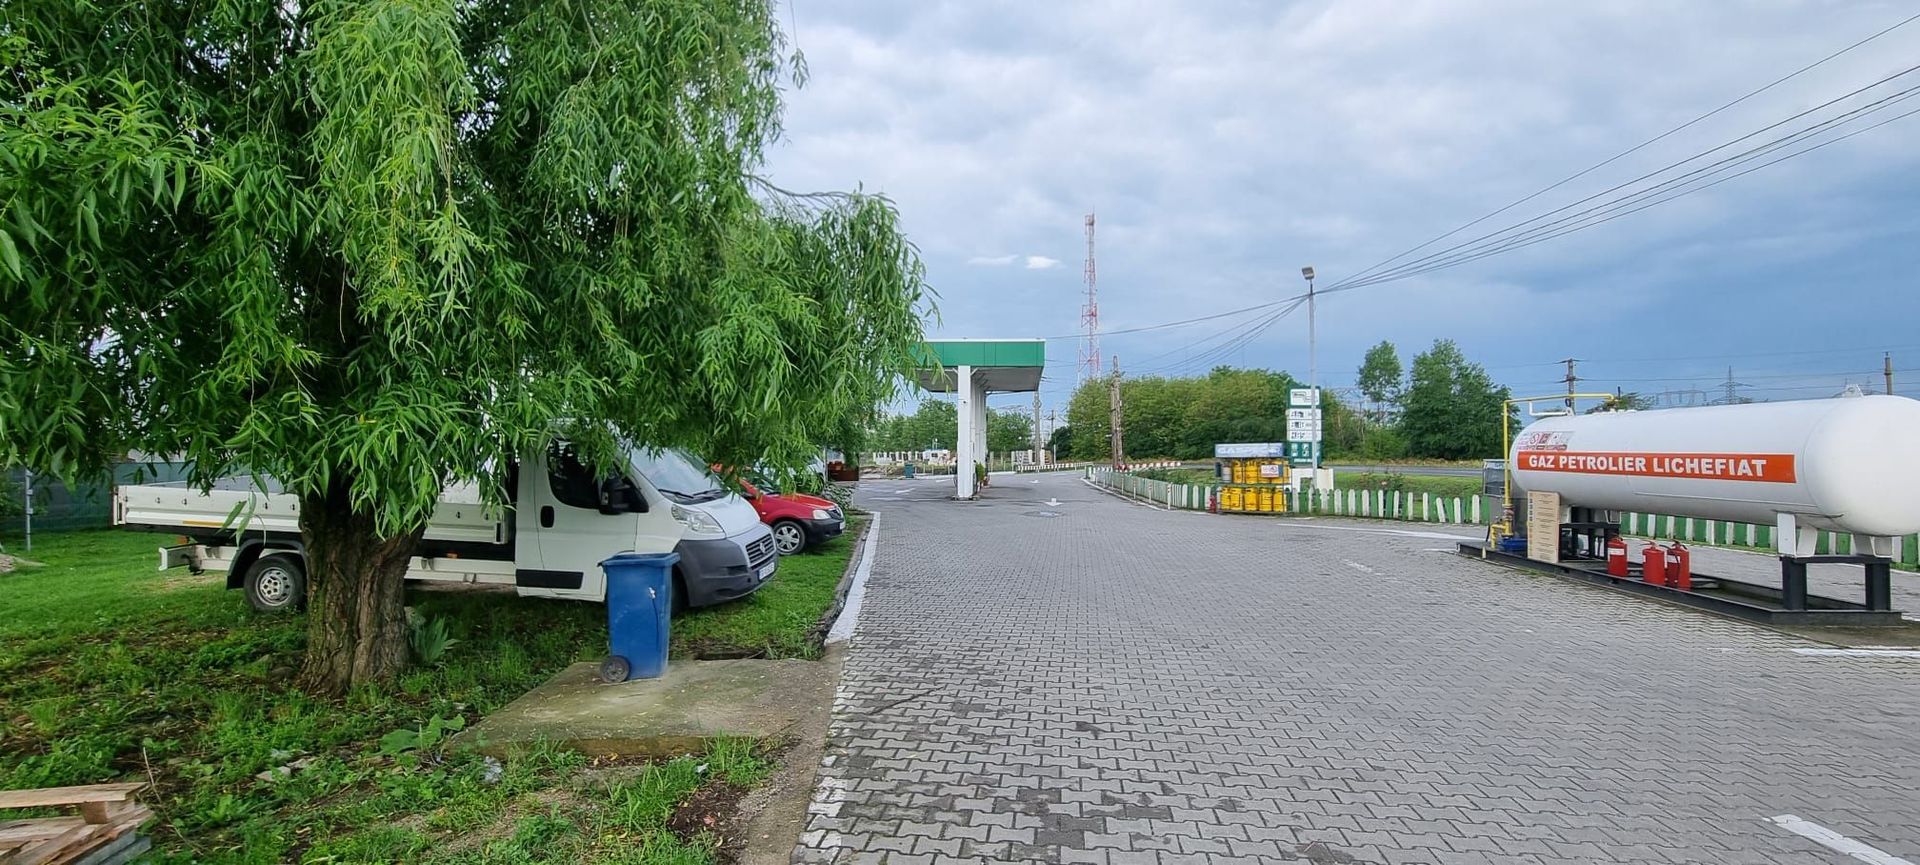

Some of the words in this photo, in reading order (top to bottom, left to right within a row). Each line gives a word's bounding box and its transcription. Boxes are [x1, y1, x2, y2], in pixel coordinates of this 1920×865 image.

[1529, 455, 1555, 468] GAZ
[1559, 456, 1647, 473] PETROLIER
[1652, 458, 1767, 478] LICHEFIAT
